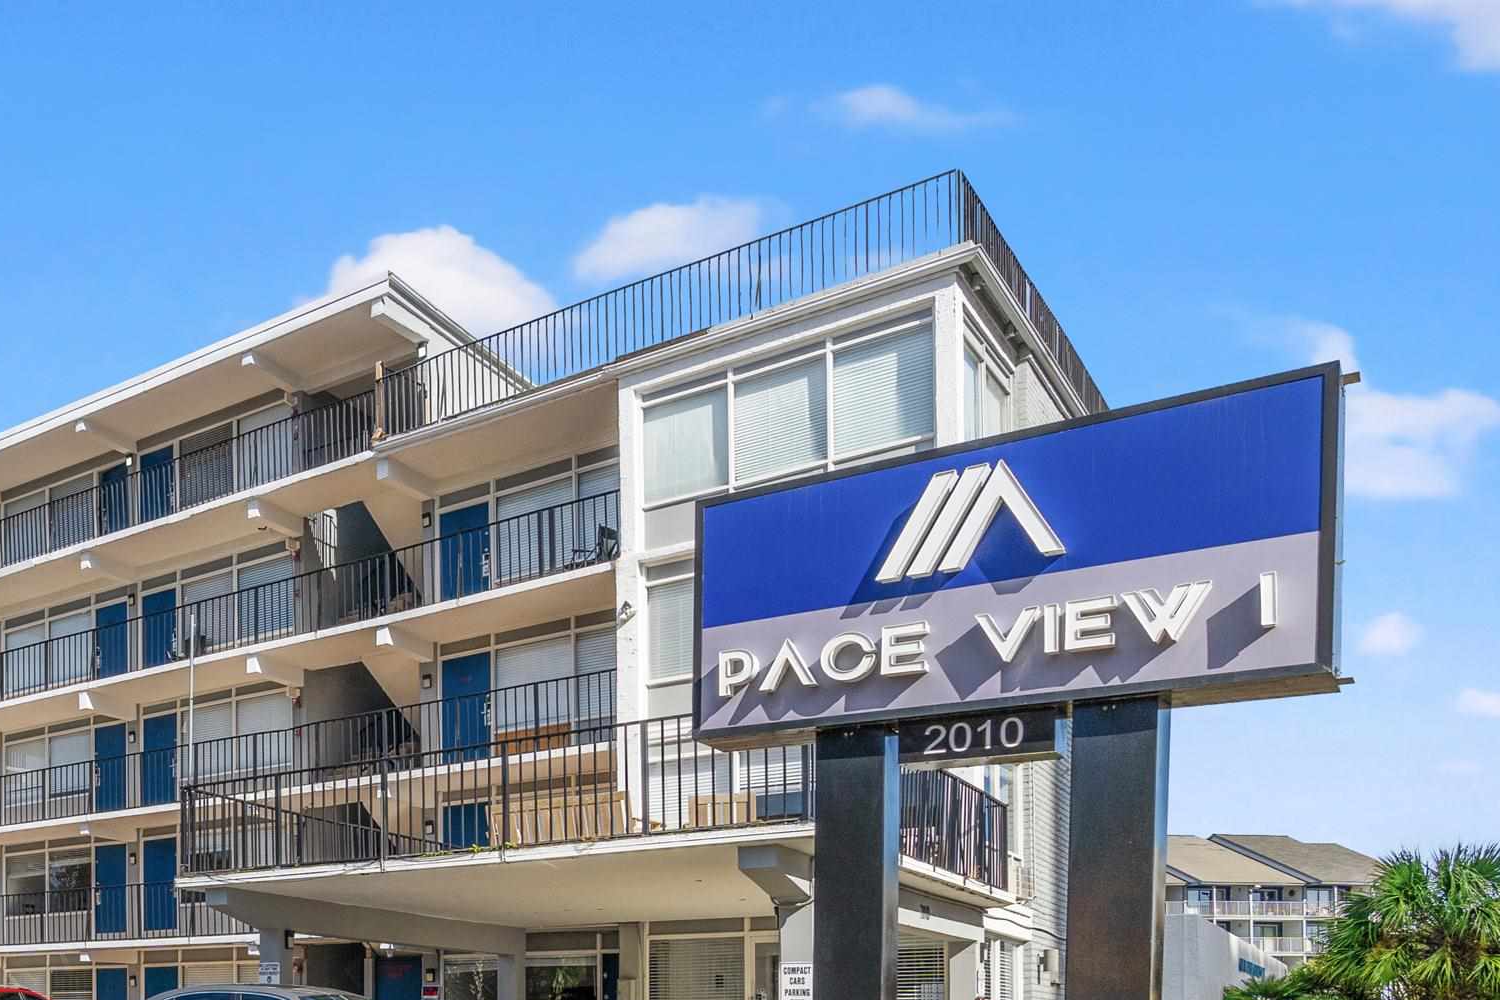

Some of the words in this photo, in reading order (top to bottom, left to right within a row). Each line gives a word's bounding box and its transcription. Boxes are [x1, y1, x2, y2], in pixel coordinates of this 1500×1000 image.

[718, 619, 931, 697] PACE
[974, 580, 1213, 663] VIEW
[923, 716, 1024, 756] 2010
[783, 966, 811, 974] COMPACT
[789, 977, 805, 985] CARS
[784, 988, 811, 997] PARKING
